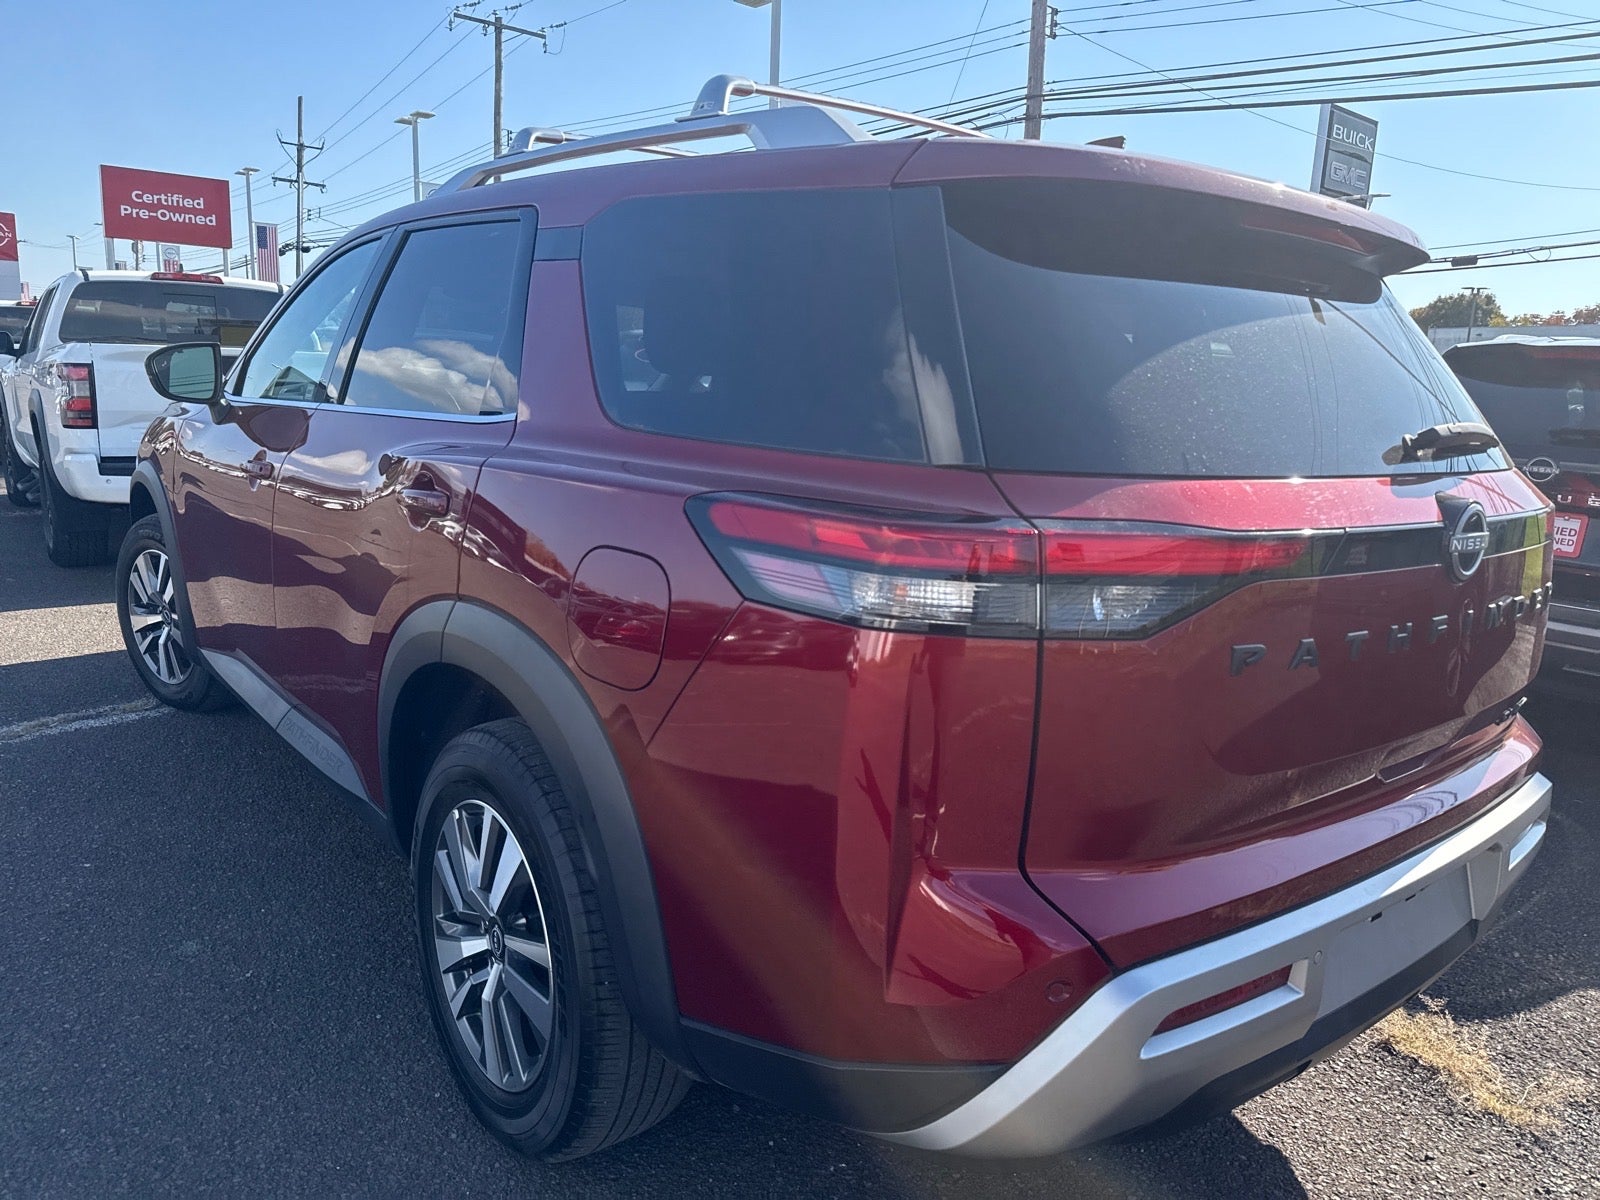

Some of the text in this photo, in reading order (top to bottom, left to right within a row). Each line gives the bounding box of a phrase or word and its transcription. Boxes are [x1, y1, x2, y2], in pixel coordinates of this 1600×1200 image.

[1333, 124, 1375, 152] BUICK
[1331, 161, 1366, 189] GMC
[131, 190, 204, 209] Certified
[120, 205, 217, 226] Pre-Owned
[1523, 465, 1560, 476] NISSAN
[1451, 537, 1488, 552] NISS
